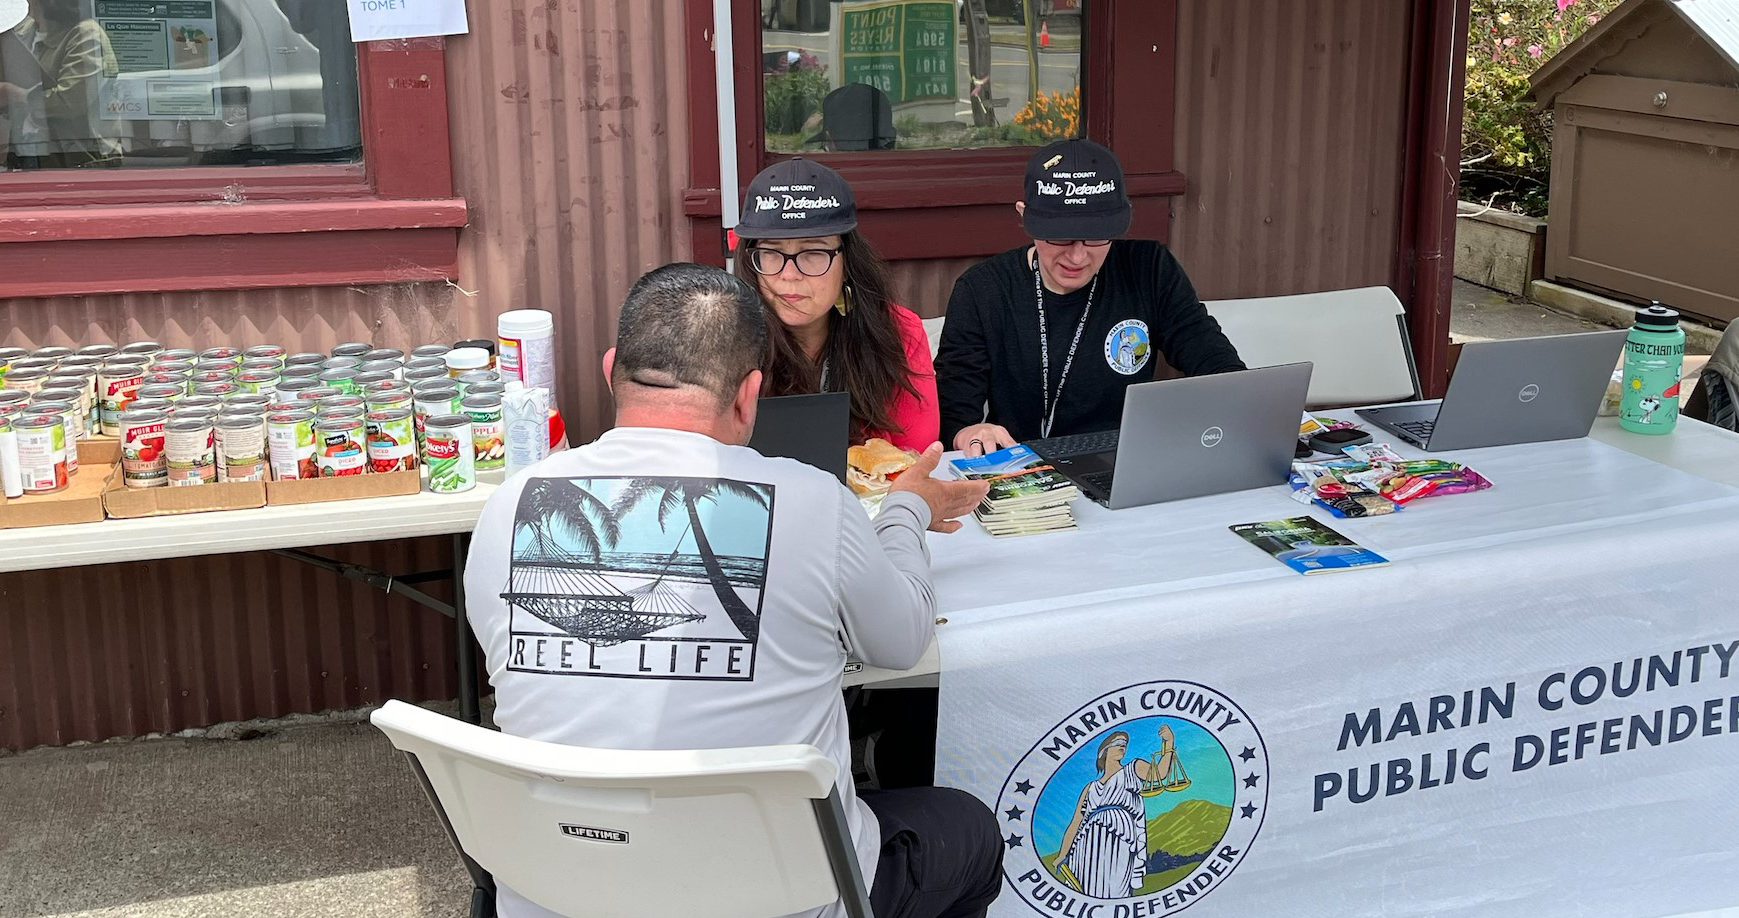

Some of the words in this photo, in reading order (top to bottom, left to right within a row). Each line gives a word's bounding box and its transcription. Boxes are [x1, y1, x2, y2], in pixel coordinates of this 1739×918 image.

[362, 1, 396, 11] TOME
[1036, 180, 1063, 195] Public
[755, 195, 780, 213] Public
[1110, 323, 1124, 337] MARIN
[1041, 333, 1049, 368] DEFENDER
[1062, 355, 1073, 378] PUBLIC
[1069, 323, 1085, 355] DEFENDER
[1626, 343, 1646, 354] TTER
[1646, 344, 1672, 355] THAN
[114, 380, 131, 390] MUIR
[131, 426, 150, 436] MUIR
[473, 426, 498, 435] PPLE
[513, 638, 601, 670] REEL
[638, 643, 742, 674] LIFE
[1337, 682, 1515, 751] MARIN
[1538, 640, 1739, 711] COUNTY
[1042, 696, 1127, 761] MARIN
[1140, 688, 1241, 733] COUNTY
[1313, 742, 1490, 812] PUBLIC
[568, 827, 620, 840] LIFETIME
[1017, 868, 1104, 918] PUBLIC
[1114, 845, 1240, 918] DEFENDER
